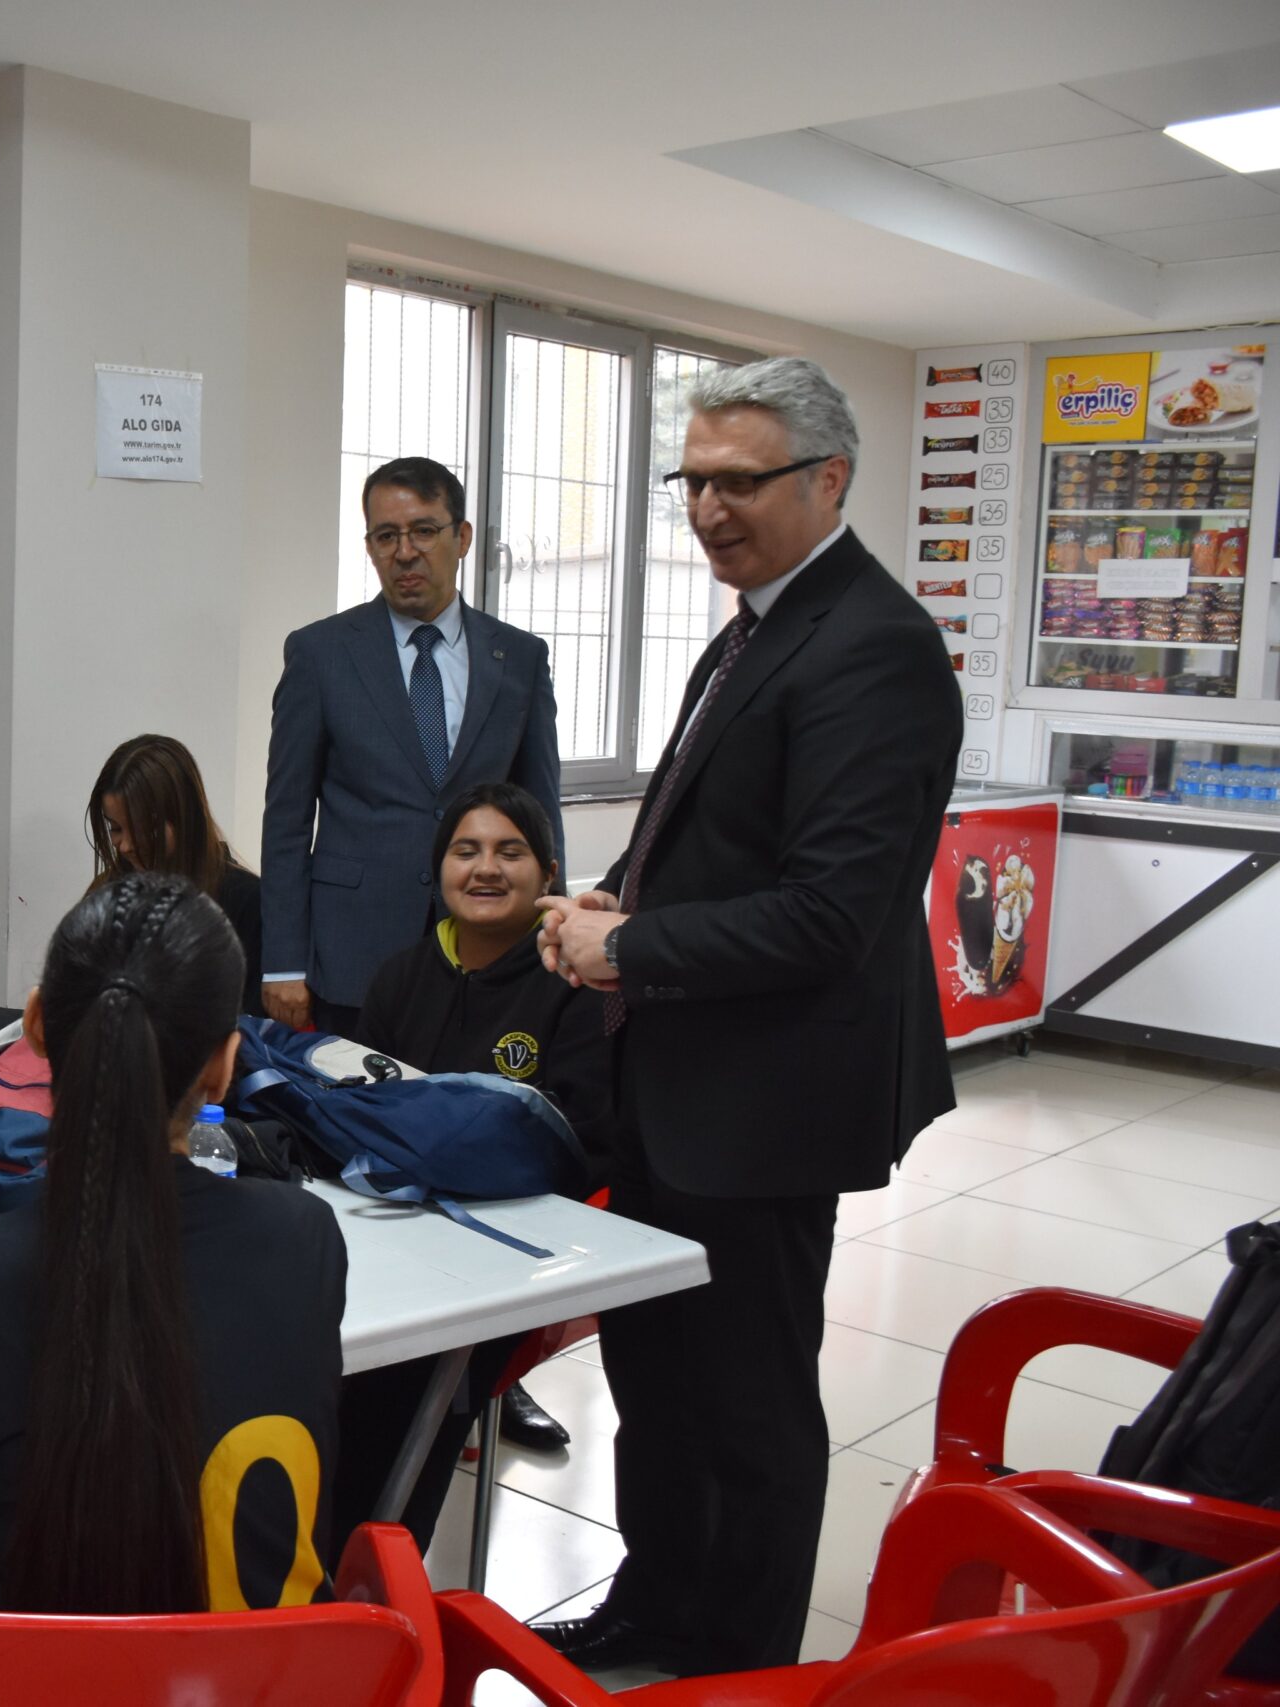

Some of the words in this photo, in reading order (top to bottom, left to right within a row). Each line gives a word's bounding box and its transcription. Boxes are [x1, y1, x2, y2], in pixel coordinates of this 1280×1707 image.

[991, 365, 1011, 379] 40
[140, 394, 162, 407] 174
[1061, 387, 1133, 414] erpiliç
[988, 400, 1011, 420] 35
[121, 418, 147, 431] ALO
[151, 419, 182, 432] GIDA
[986, 429, 1009, 449] 35
[983, 467, 1005, 486] 25
[980, 539, 1000, 558] 35
[972, 655, 991, 672] 35
[969, 698, 990, 713] 20
[966, 754, 983, 770] 25
